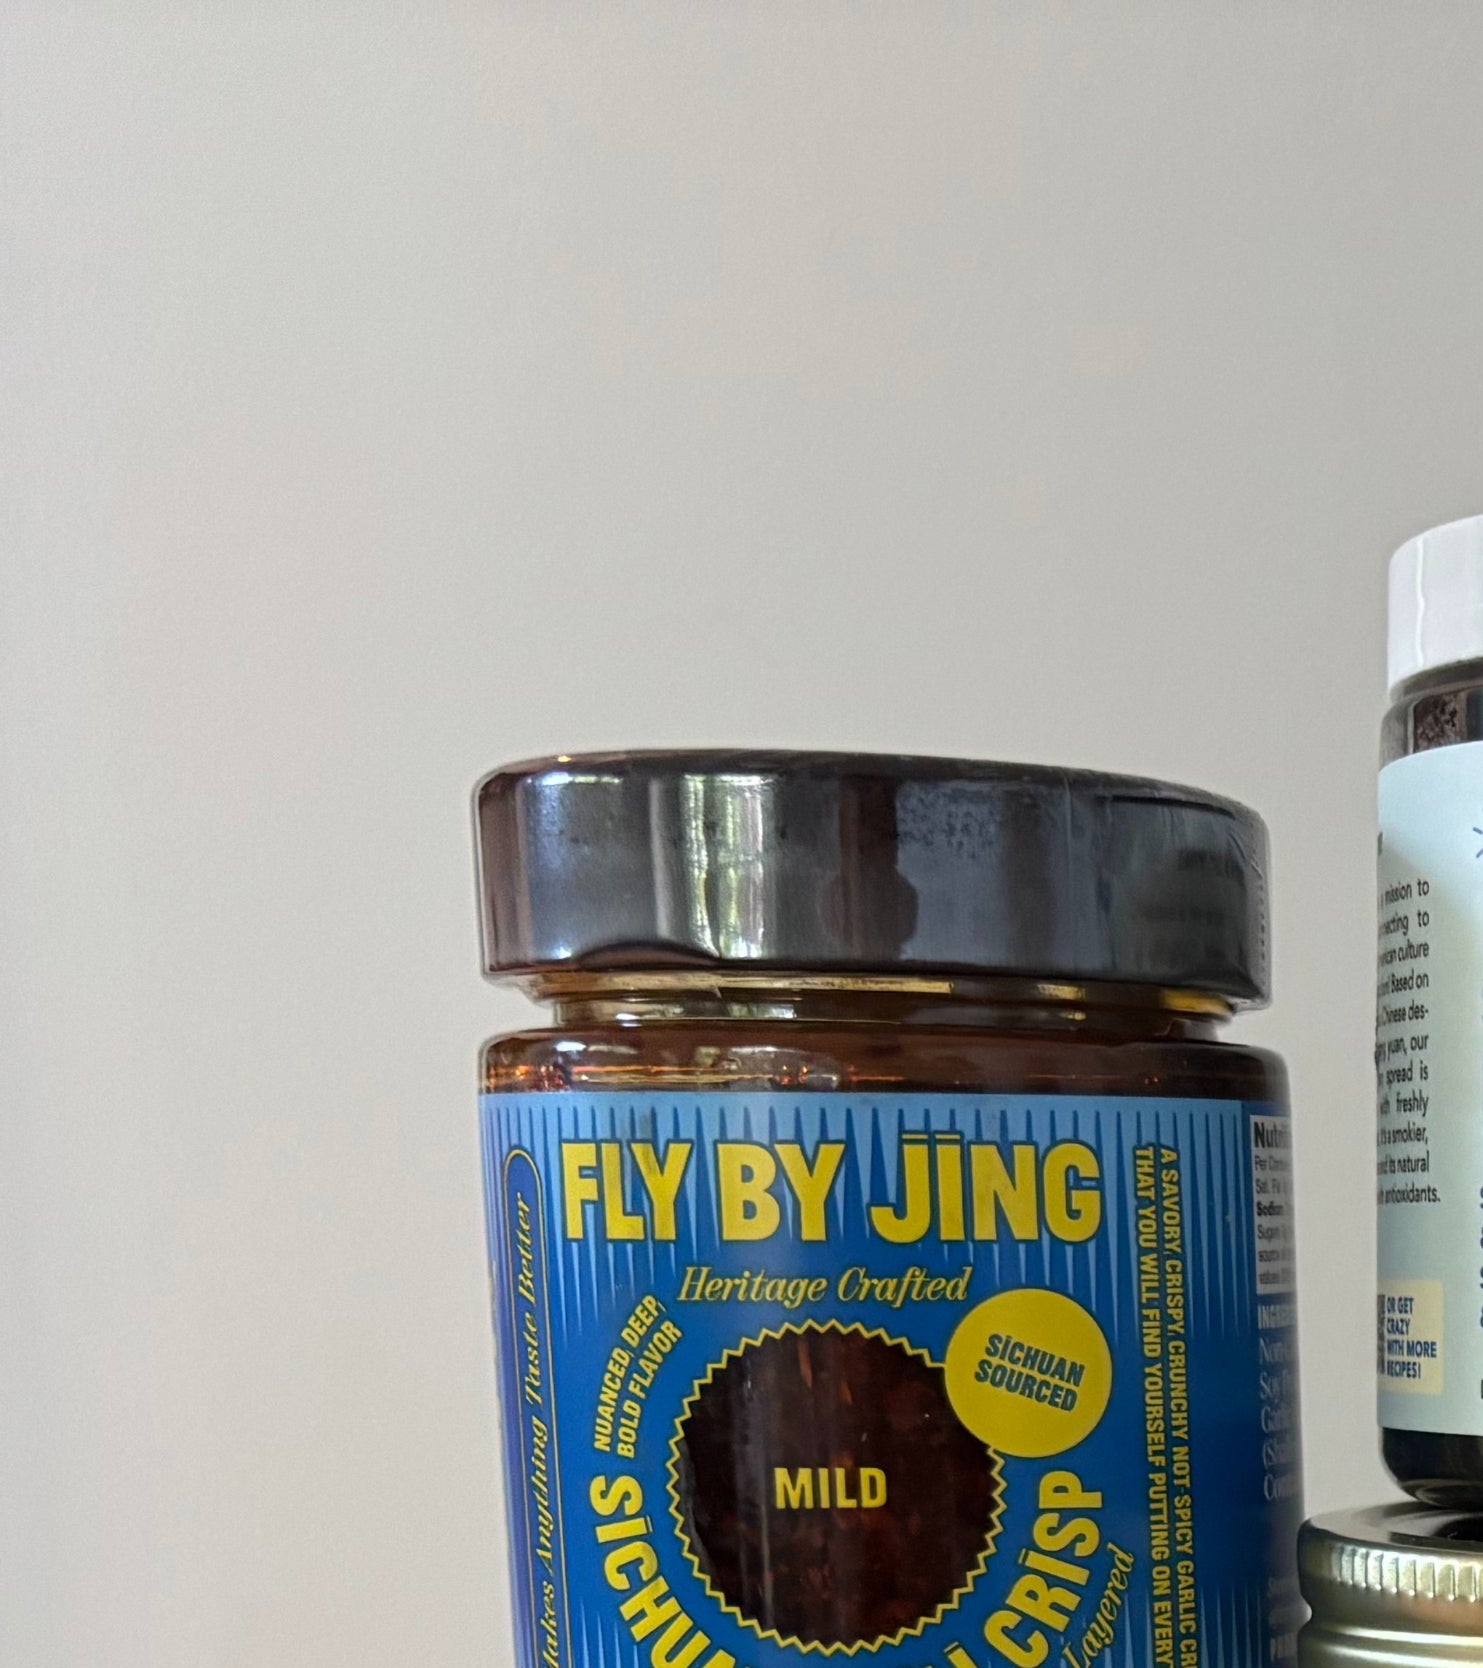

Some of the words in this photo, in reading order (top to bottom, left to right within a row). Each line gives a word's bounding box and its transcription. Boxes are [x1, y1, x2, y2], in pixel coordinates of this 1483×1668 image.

[1135, 1148, 1155, 1199] THAT
[1397, 1150, 1430, 1174] natural
[561, 1142, 693, 1241] FLY
[716, 1142, 845, 1241] BY
[1138, 1205, 1157, 1248] YOU
[677, 1266, 827, 1308] Heritage
[838, 1265, 974, 1308] Crafted
[1140, 1254, 1160, 1303] WILL
[1142, 1309, 1162, 1359] FIND
[617, 1400, 641, 1458] BOLD
[629, 1320, 682, 1399] FLAVOR
[974, 1359, 1078, 1412] SOURCED
[1144, 1362, 1166, 1467] YOURSELF
[774, 1467, 888, 1510] MILD
[1148, 1472, 1170, 1561] PUTTING
[1152, 1565, 1171, 1596] ON
